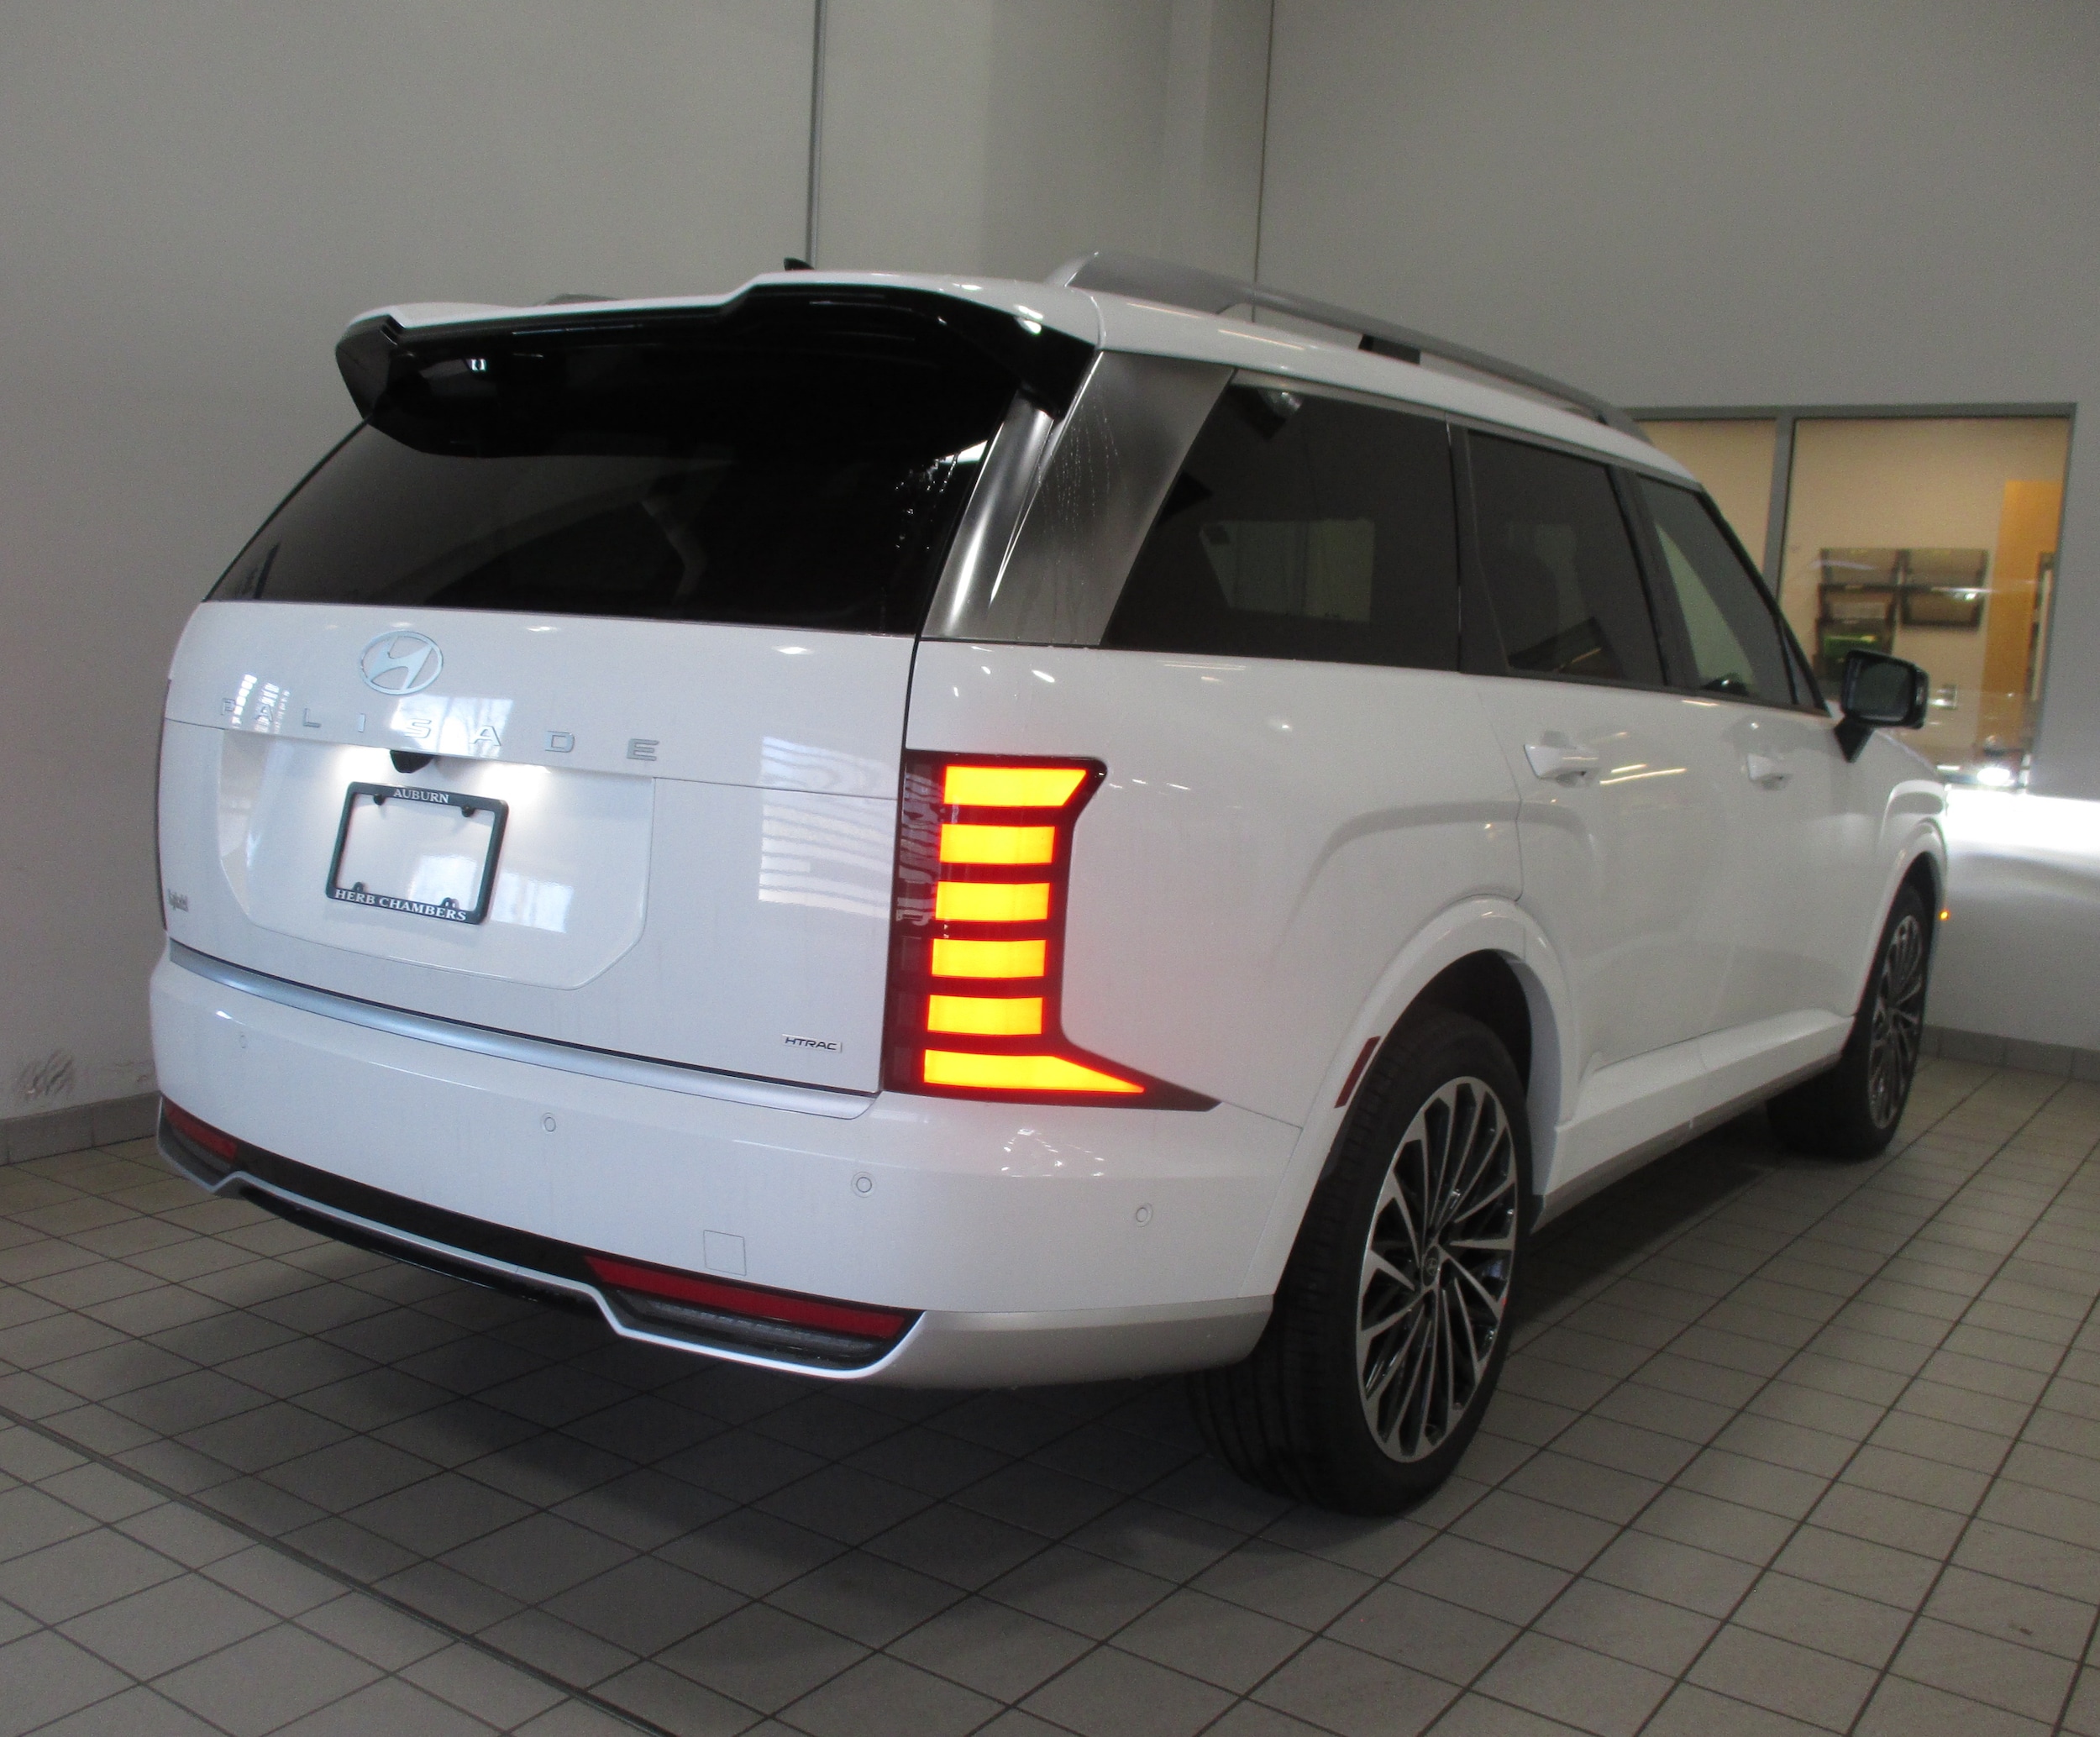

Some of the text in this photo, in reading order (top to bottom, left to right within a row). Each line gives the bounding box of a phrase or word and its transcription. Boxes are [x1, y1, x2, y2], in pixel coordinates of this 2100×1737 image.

[220, 697, 660, 762] PALISADE
[393, 788, 449, 803] AUBURN
[334, 889, 466, 921] HERB CHAMBERS
[785, 1036, 837, 1051] HTRAC
